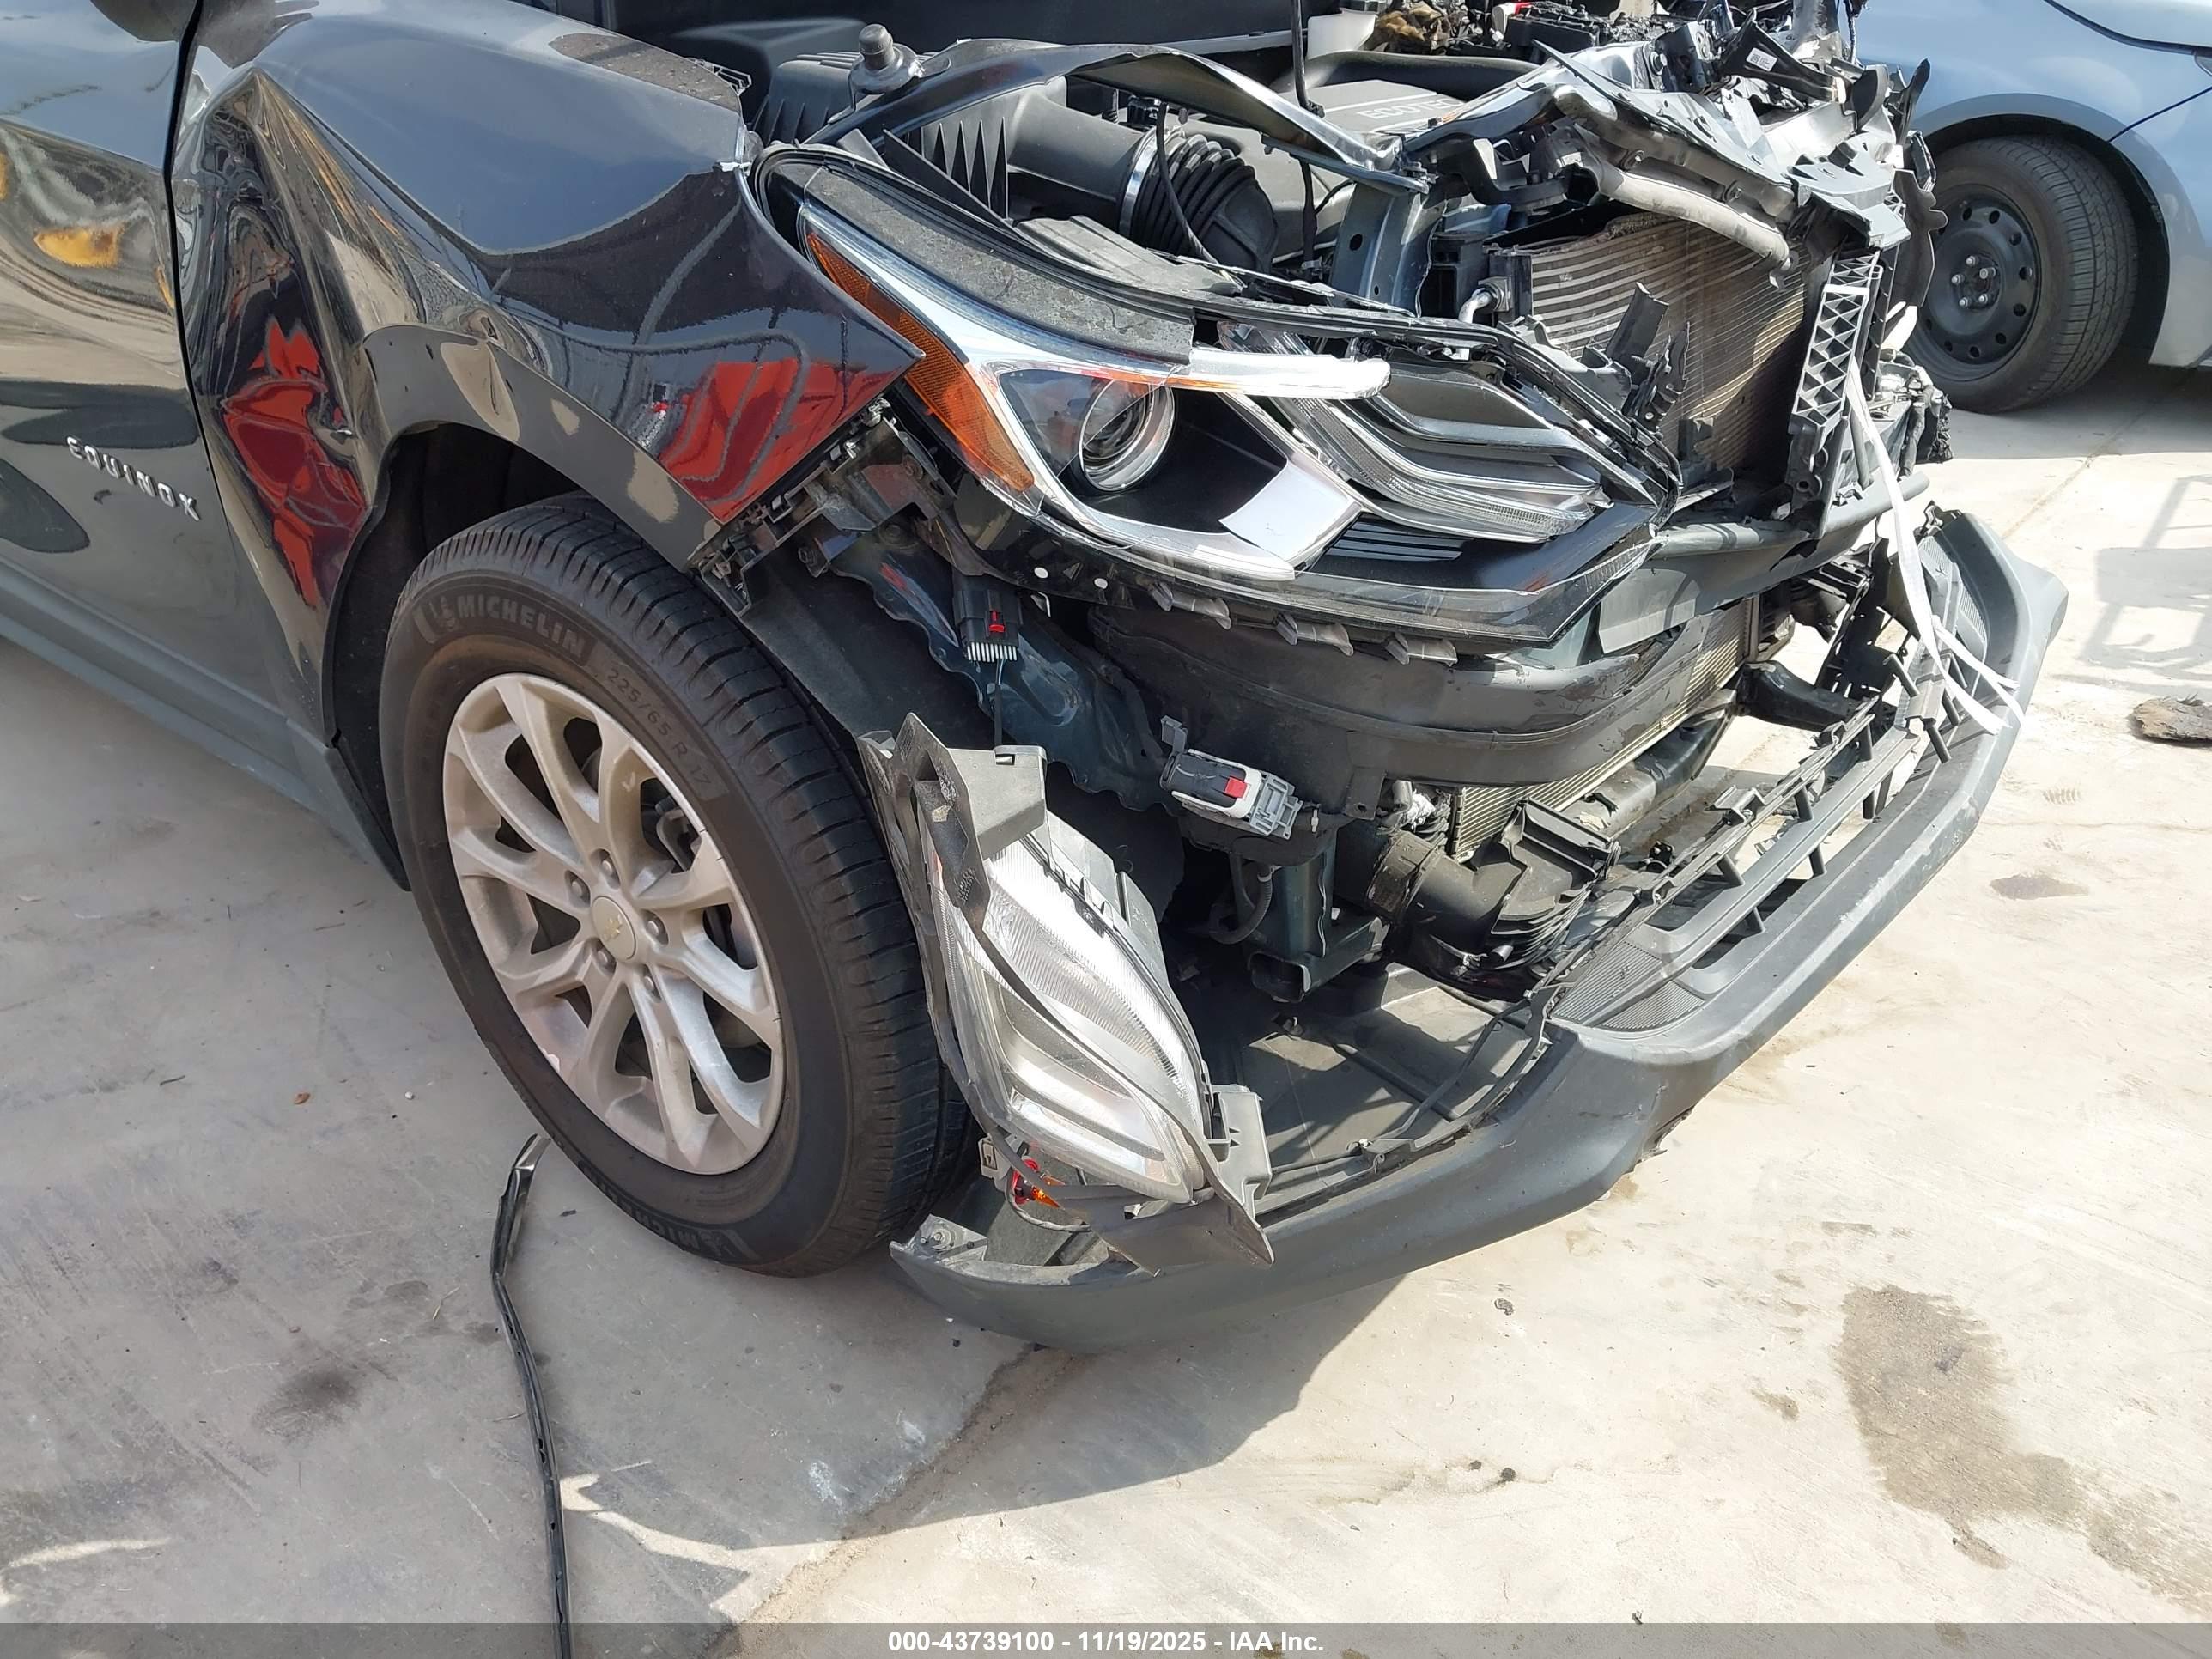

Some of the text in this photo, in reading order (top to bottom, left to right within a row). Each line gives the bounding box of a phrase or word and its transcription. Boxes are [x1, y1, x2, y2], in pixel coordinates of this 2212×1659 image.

[1356, 98, 1463, 119] ECOTEC
[65, 435, 201, 522] EQUINOX
[456, 594, 586, 658] MICHELIN
[607, 668, 672, 736] 225/65
